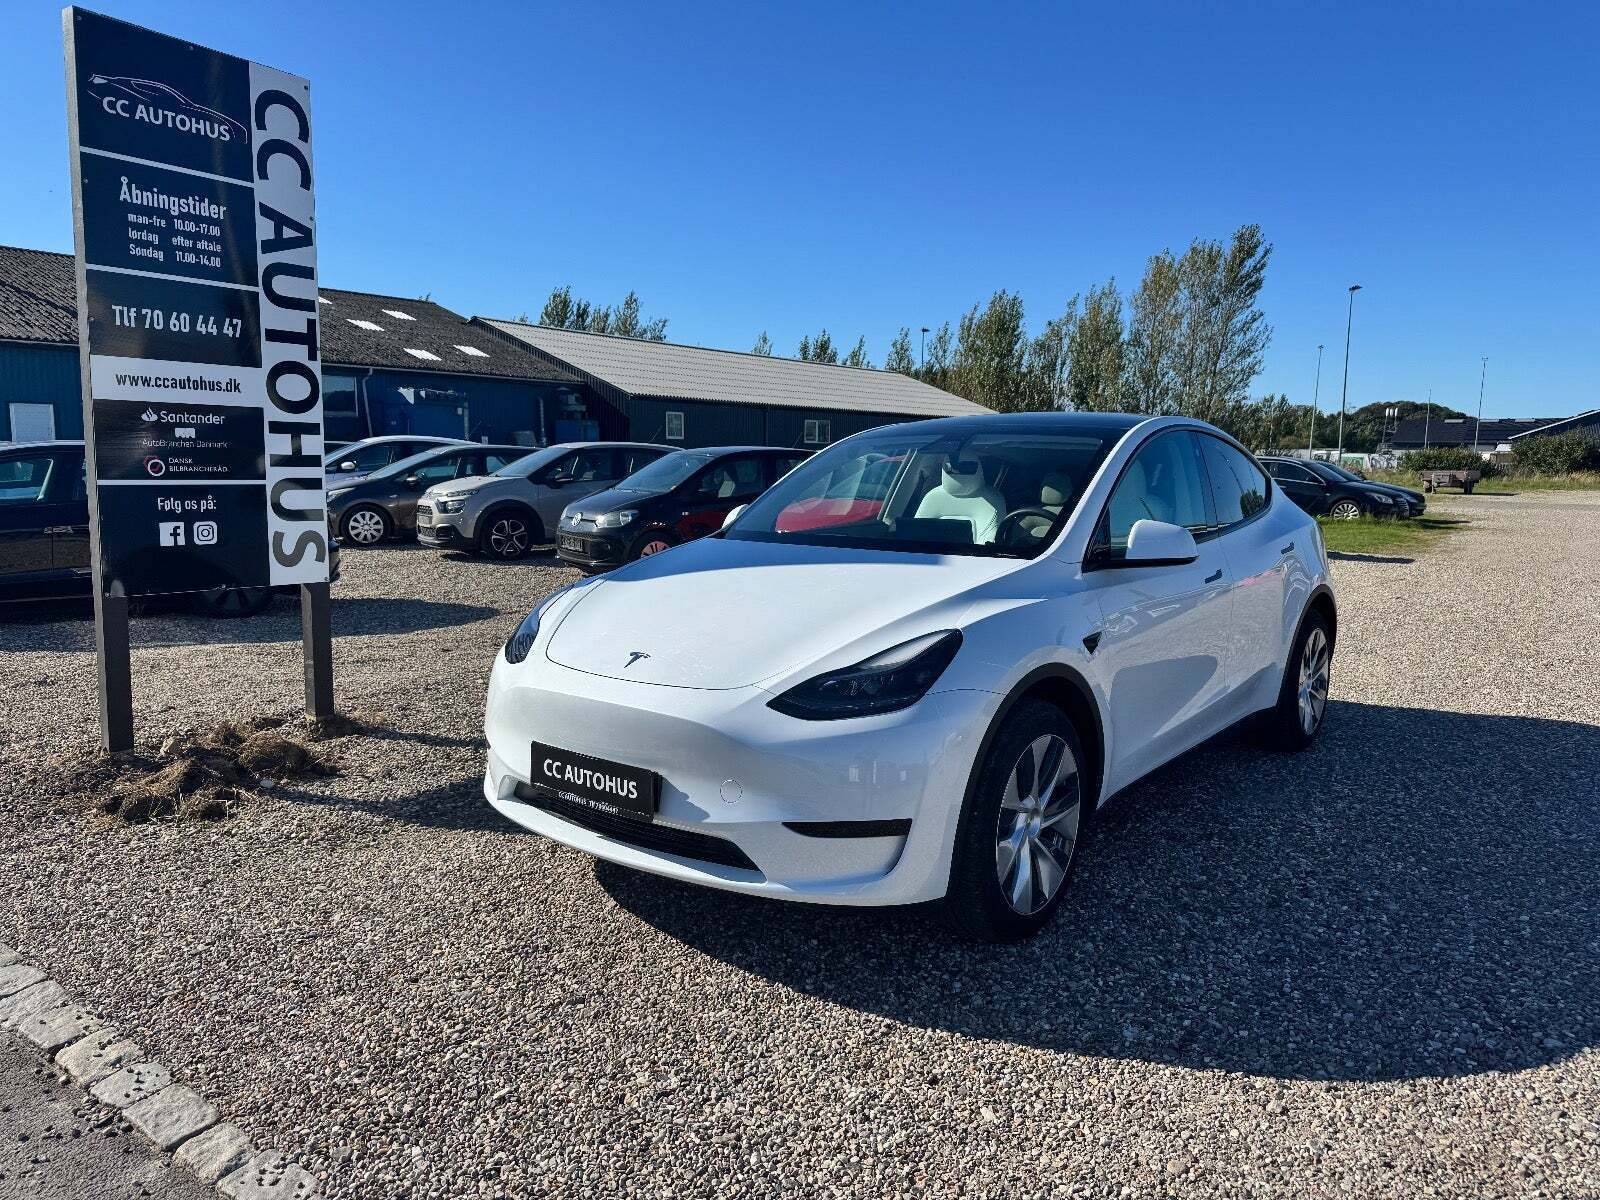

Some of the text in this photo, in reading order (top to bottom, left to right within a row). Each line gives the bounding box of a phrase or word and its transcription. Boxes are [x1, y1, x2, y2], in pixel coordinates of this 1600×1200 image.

[102, 96, 231, 142] CC AUTOHUS
[119, 176, 227, 220] Åbningstider
[127, 212, 221, 237] man-fre 10.00-17.00
[128, 228, 222, 252] lørdag efter aftale
[129, 243, 221, 268] Søndag 11.00-14.00
[111, 305, 242, 338] Tlf 70 60 44 47
[254, 89, 326, 568] CC AUTOHUS
[115, 373, 242, 393] www.ccautohus.dk
[160, 410, 225, 425] Santander
[157, 495, 217, 514] Følg os på:
[543, 758, 638, 799] CC AUTOHUS
